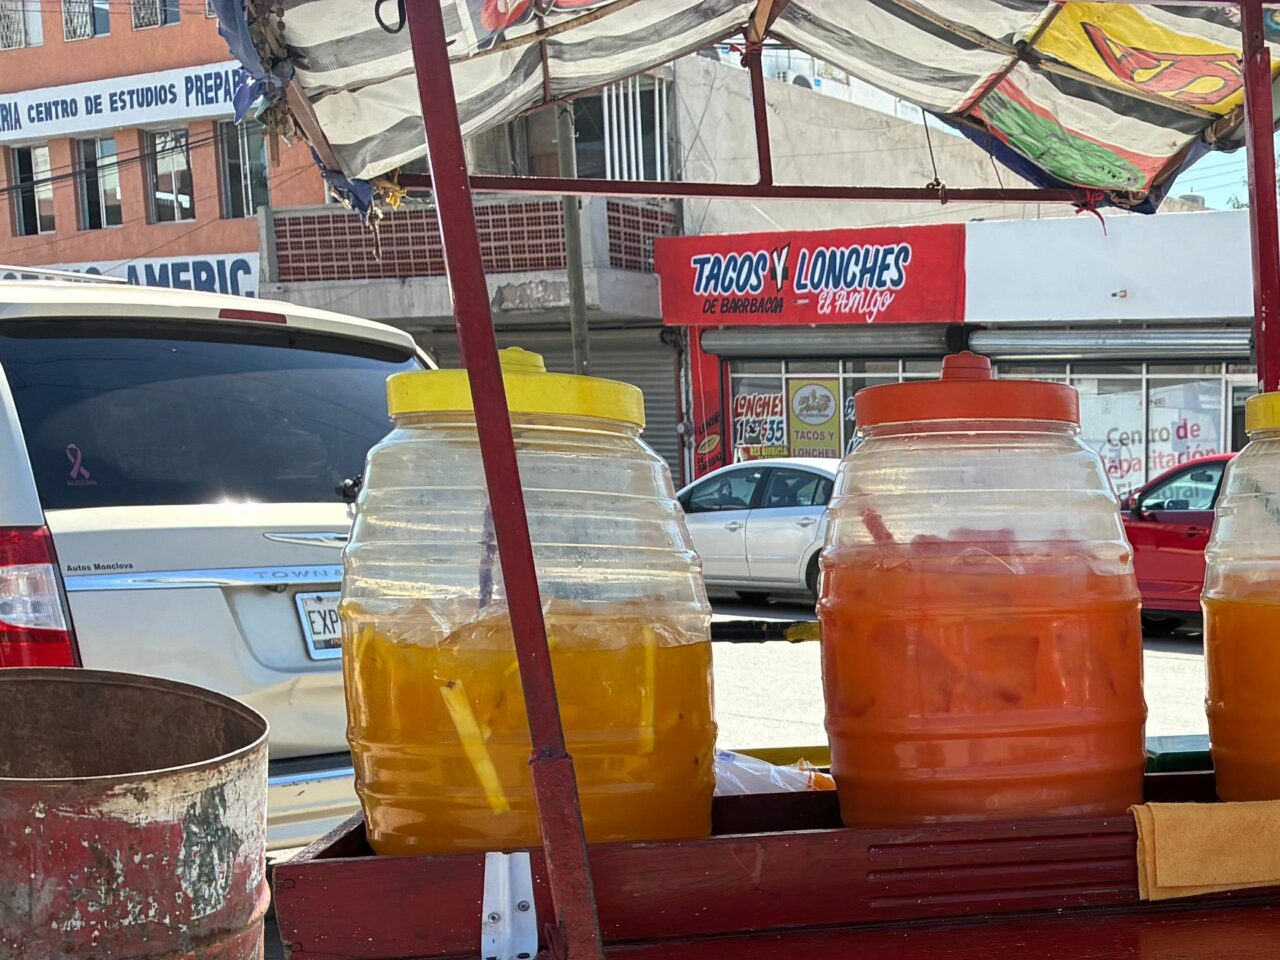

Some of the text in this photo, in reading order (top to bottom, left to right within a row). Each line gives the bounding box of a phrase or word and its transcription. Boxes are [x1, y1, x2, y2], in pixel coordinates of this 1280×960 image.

[0, 101, 22, 131] RIA
[27, 98, 79, 124] CENTRO
[85, 94, 103, 115] DE
[109, 83, 178, 112] ESTUDIOS
[691, 242, 912, 295] TACOS Y LONCHES
[702, 298, 716, 314] DE
[794, 430, 835, 440] TACOS Y
[1106, 418, 1201, 447] Cenro de
[67, 562, 133, 572] Autos Monclova
[253, 569, 328, 578] TOWN
